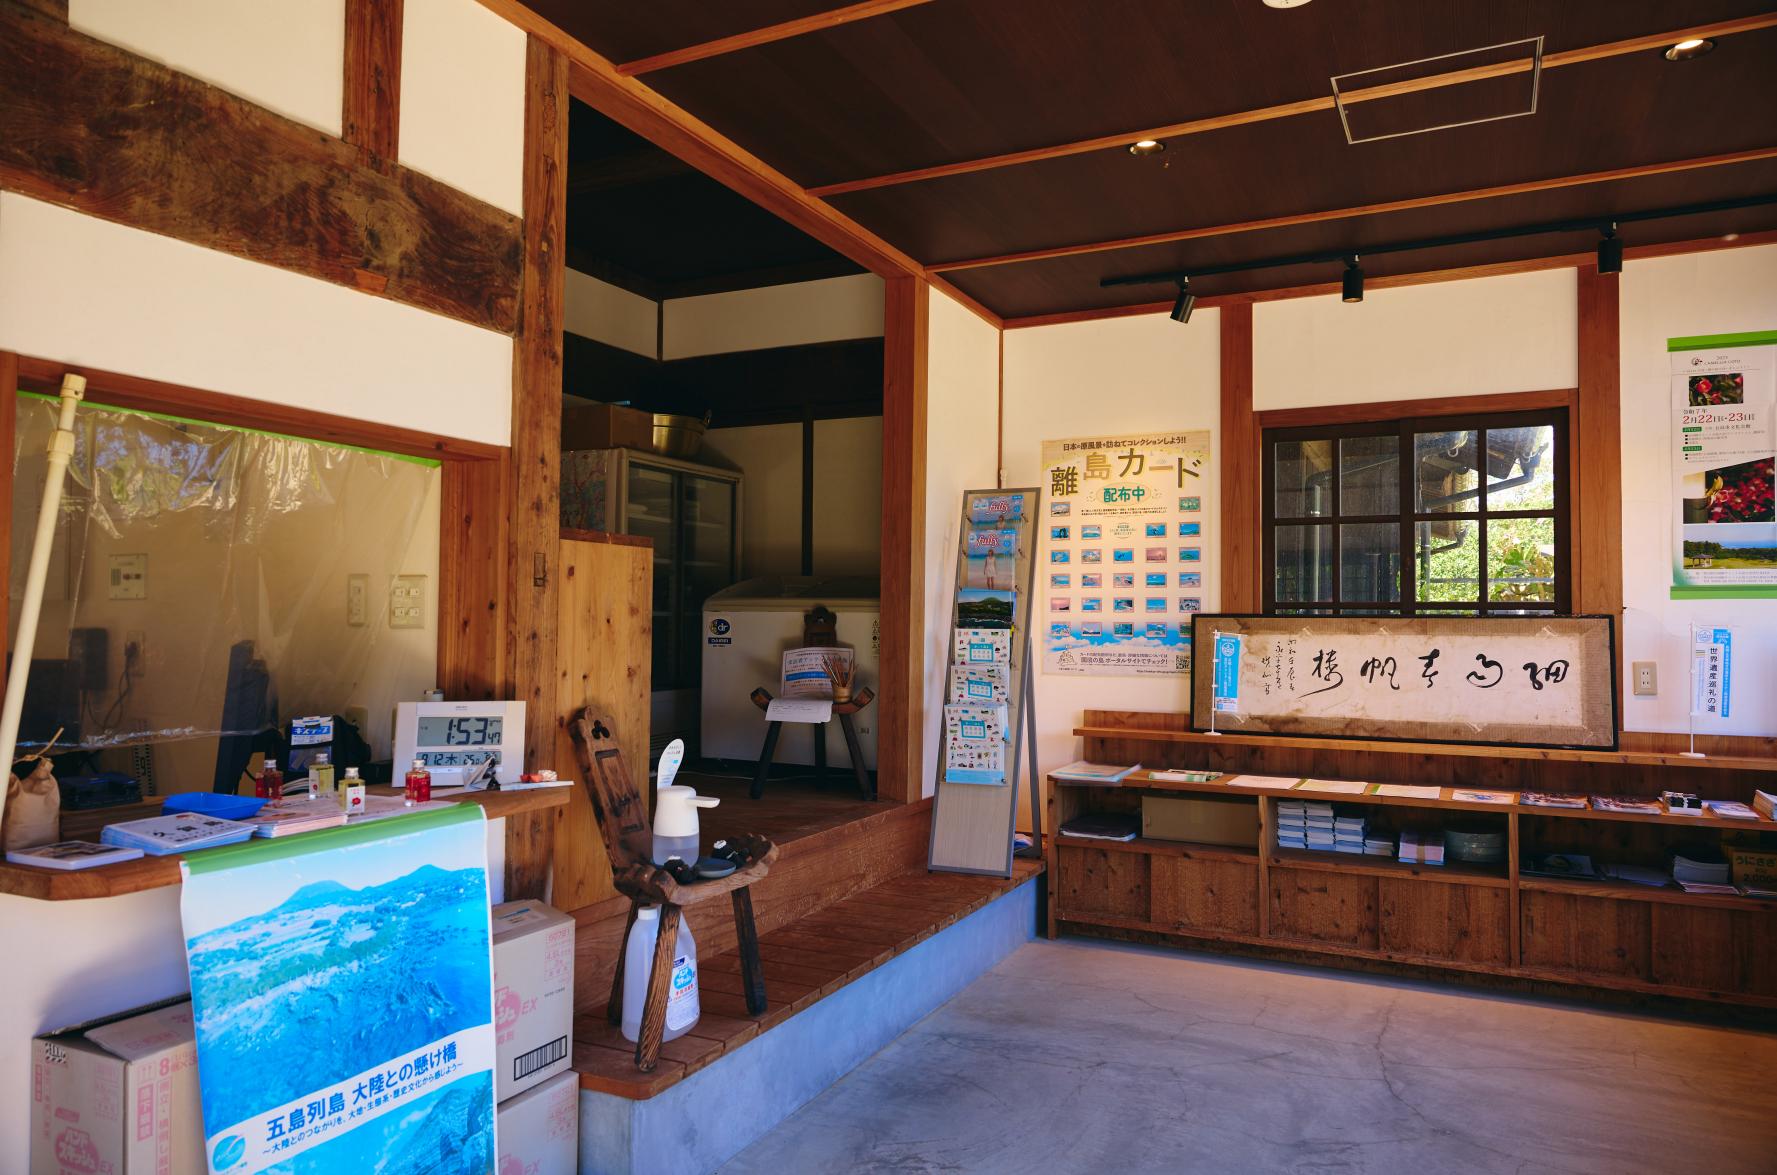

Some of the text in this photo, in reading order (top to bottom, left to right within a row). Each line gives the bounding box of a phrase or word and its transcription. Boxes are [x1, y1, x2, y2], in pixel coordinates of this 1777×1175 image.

[1050, 447, 1202, 497] 離島カード
[1103, 486, 1146, 503] 配布中
[1707, 647, 1719, 713] 世界遺産巡礼の道
[446, 718, 489, 745] 1:53
[488, 732, 501, 744] 47
[434, 753, 444, 766] 12
[445, 753, 458, 765] 木
[521, 997, 538, 1015] EX
[266, 1041, 457, 1142] 五島列島 大陸との懸け橋
